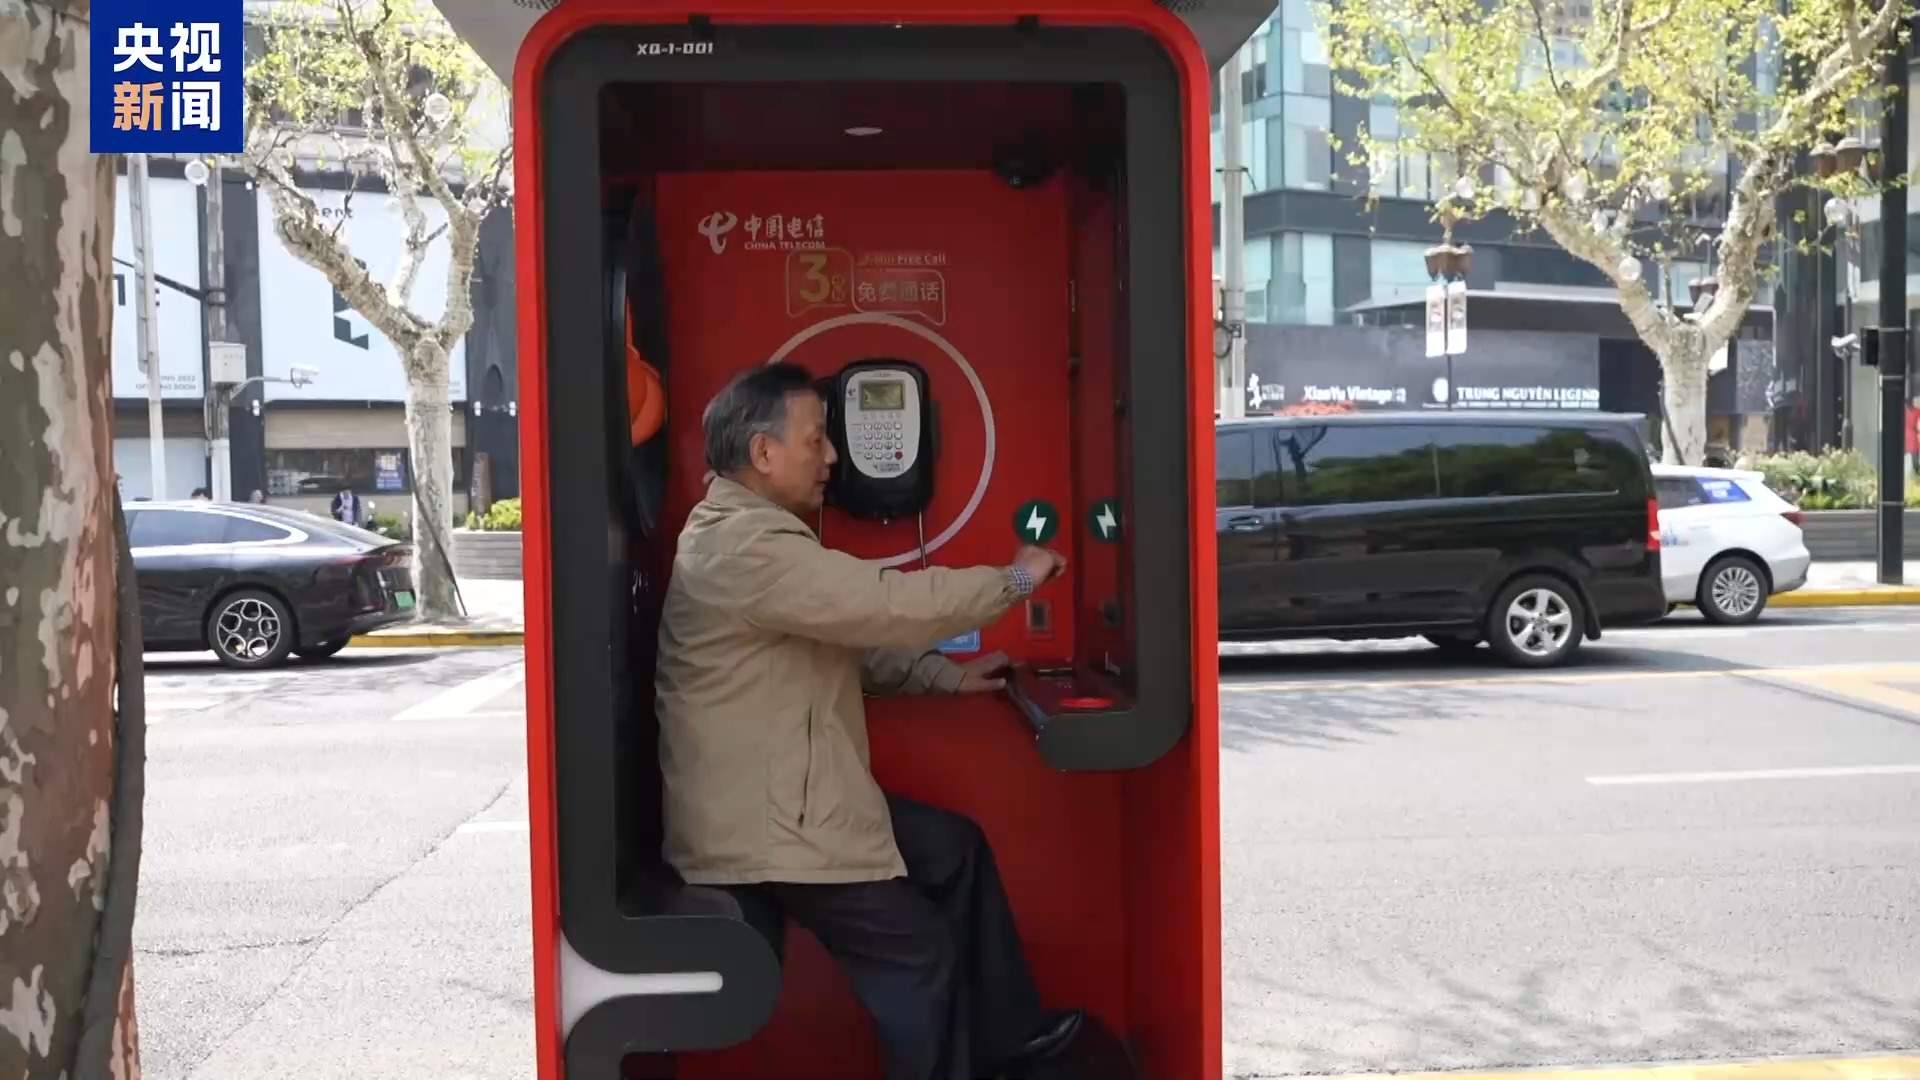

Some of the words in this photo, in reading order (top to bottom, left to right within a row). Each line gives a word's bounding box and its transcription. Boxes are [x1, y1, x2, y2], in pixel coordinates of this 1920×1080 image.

[637, 42, 714, 55] XQ-1-001
[744, 214, 825, 240] 中国电信
[744, 241, 776, 250] CHINA
[780, 240, 825, 249] TELECOM
[924, 252, 946, 265] Call
[799, 253, 830, 302] 3
[1347, 385, 1392, 404] Vintage
[1457, 387, 1500, 400] TRUNG
[1554, 387, 1600, 401] LEGEND
